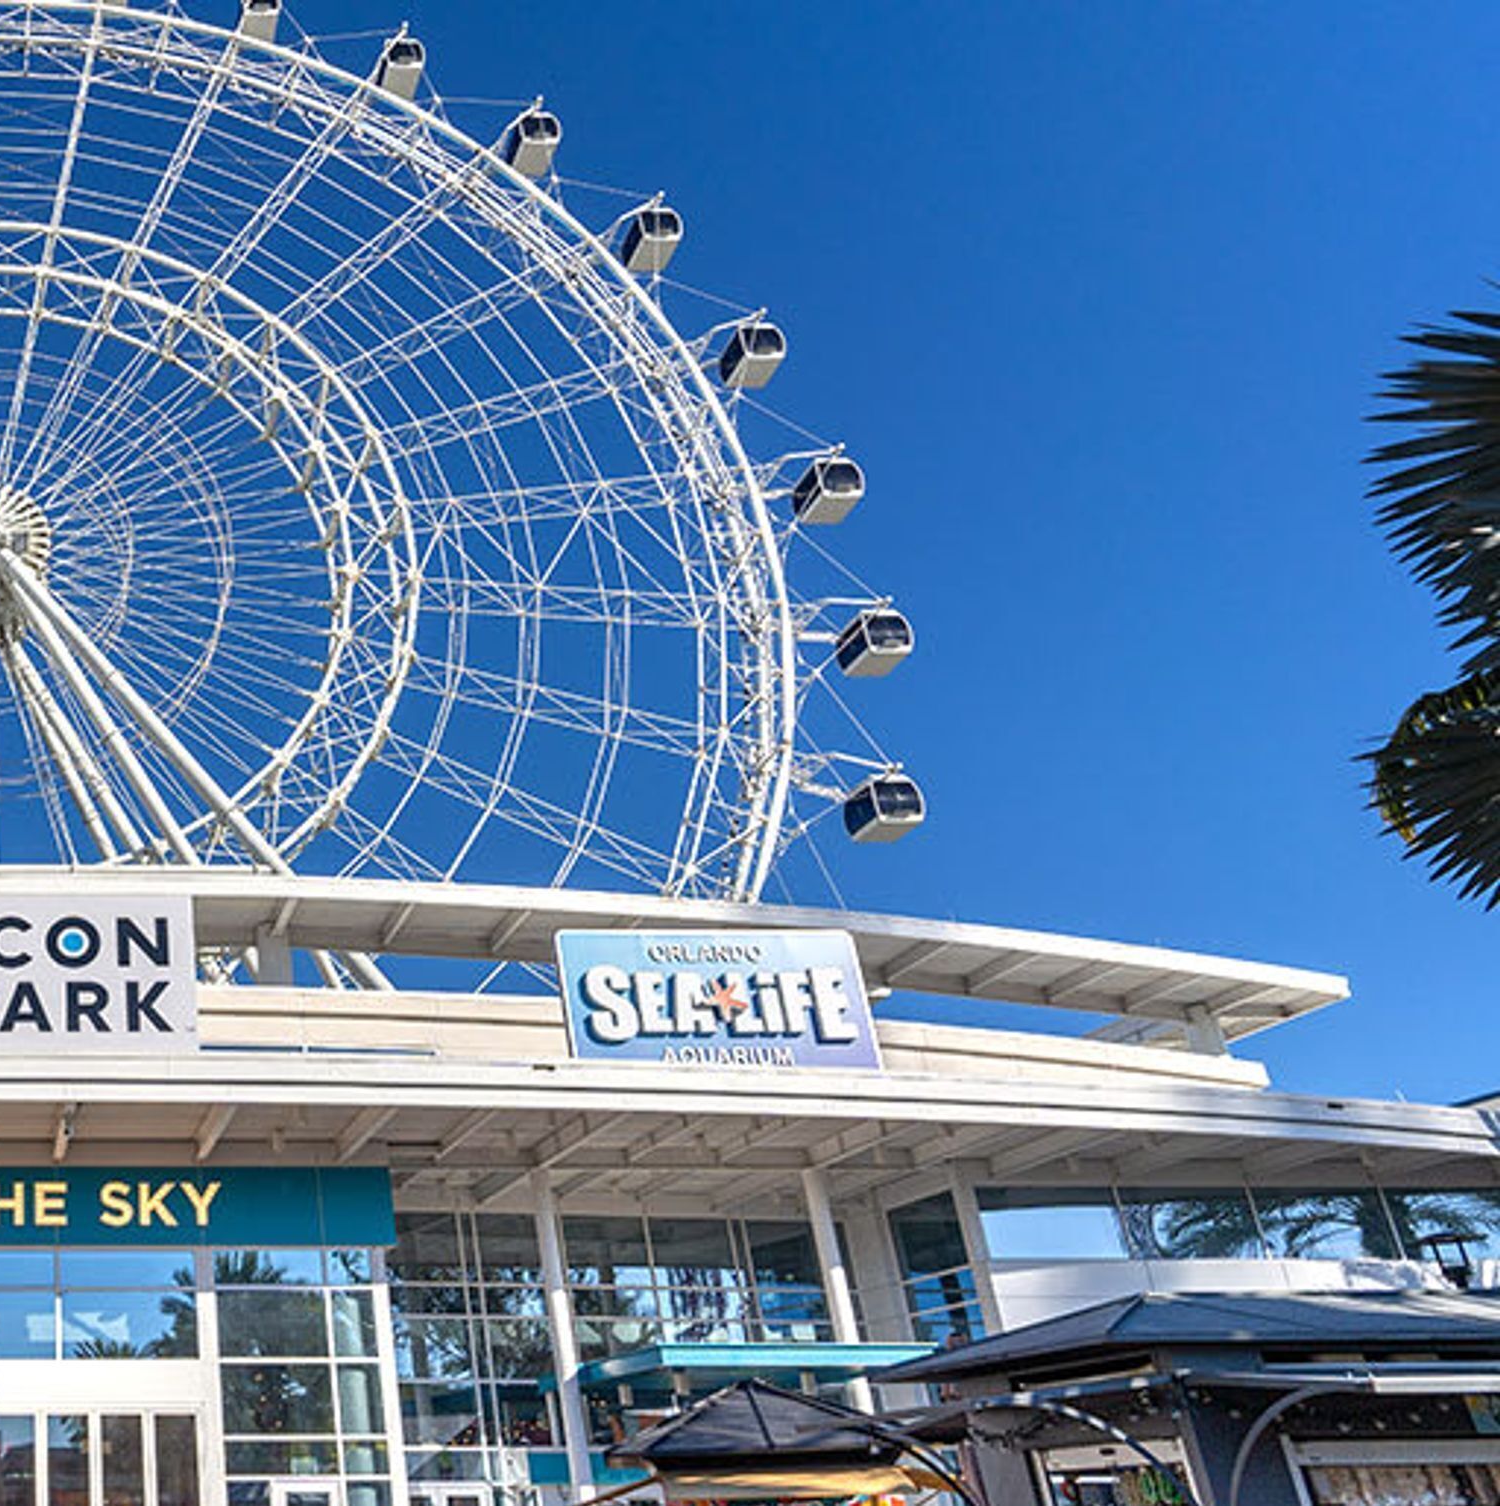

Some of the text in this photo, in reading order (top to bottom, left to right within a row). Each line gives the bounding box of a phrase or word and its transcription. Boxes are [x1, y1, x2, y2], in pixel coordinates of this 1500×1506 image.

[647, 944, 761, 964] ORLANDO
[578, 964, 719, 1046] SEA
[662, 1047, 795, 1067] AQUARIUM
[99, 1180, 221, 1227] SKY
